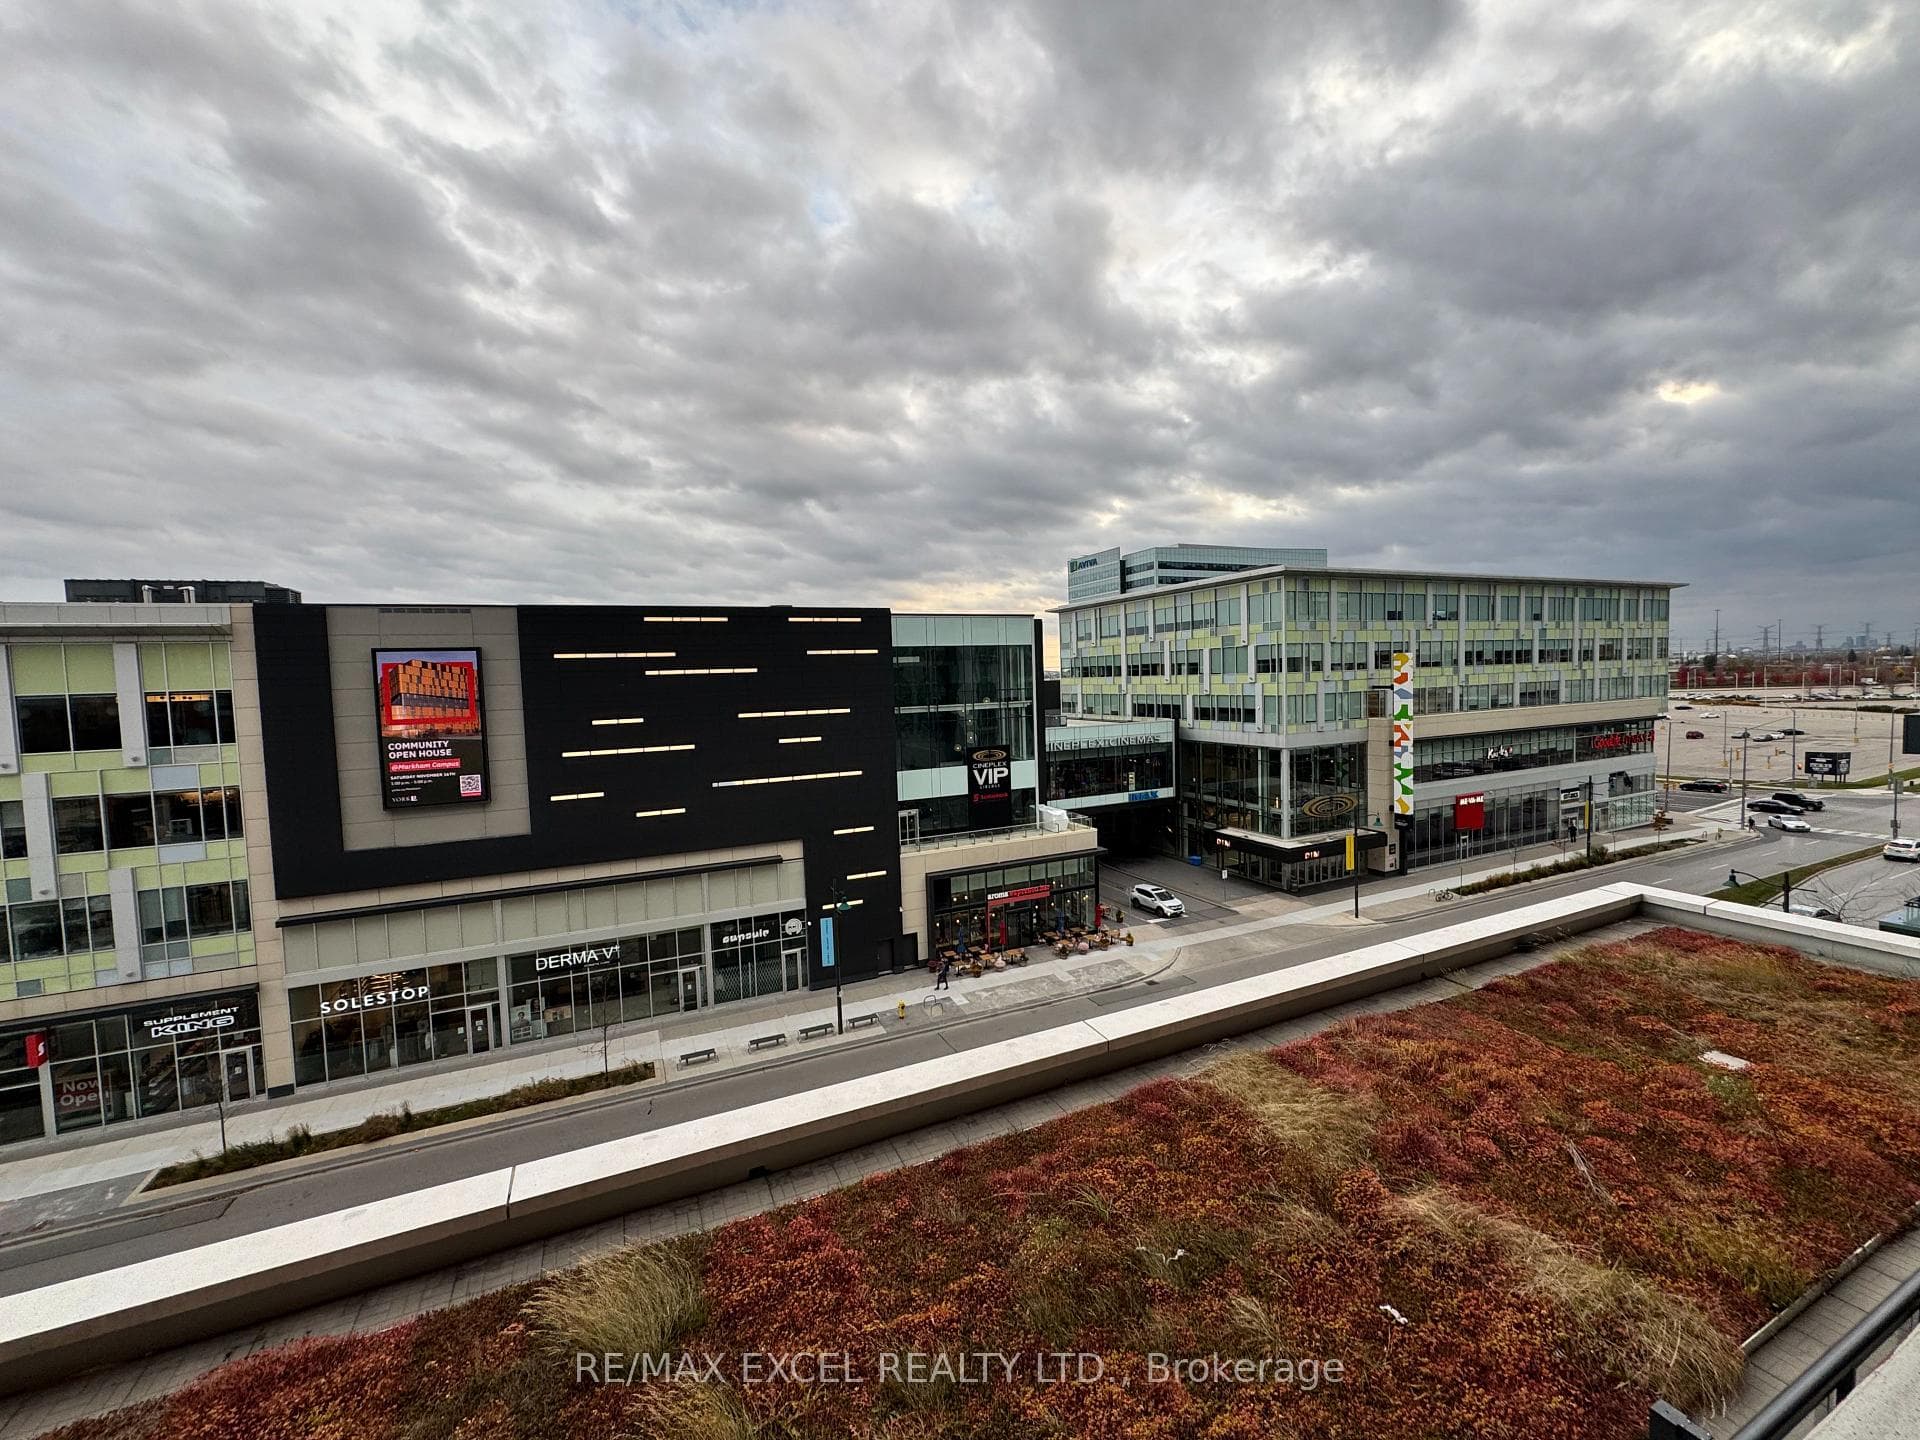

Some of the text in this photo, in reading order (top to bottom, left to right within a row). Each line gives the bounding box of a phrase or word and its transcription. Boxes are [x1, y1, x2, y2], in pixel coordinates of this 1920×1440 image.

[388, 740, 449, 751] COMMUNITY
[1046, 738, 1105, 751] INEPLEX
[388, 748, 453, 760] OPEN HOUSE
[972, 761, 1008, 769] CINEPLEX
[972, 767, 1009, 786] VIP
[987, 891, 1009, 900] aroma
[535, 950, 599, 971] DERMA
[320, 986, 428, 1014] SOLESTOP
[143, 1006, 240, 1027] SUPPLEMENT
[151, 1015, 235, 1038] KING
